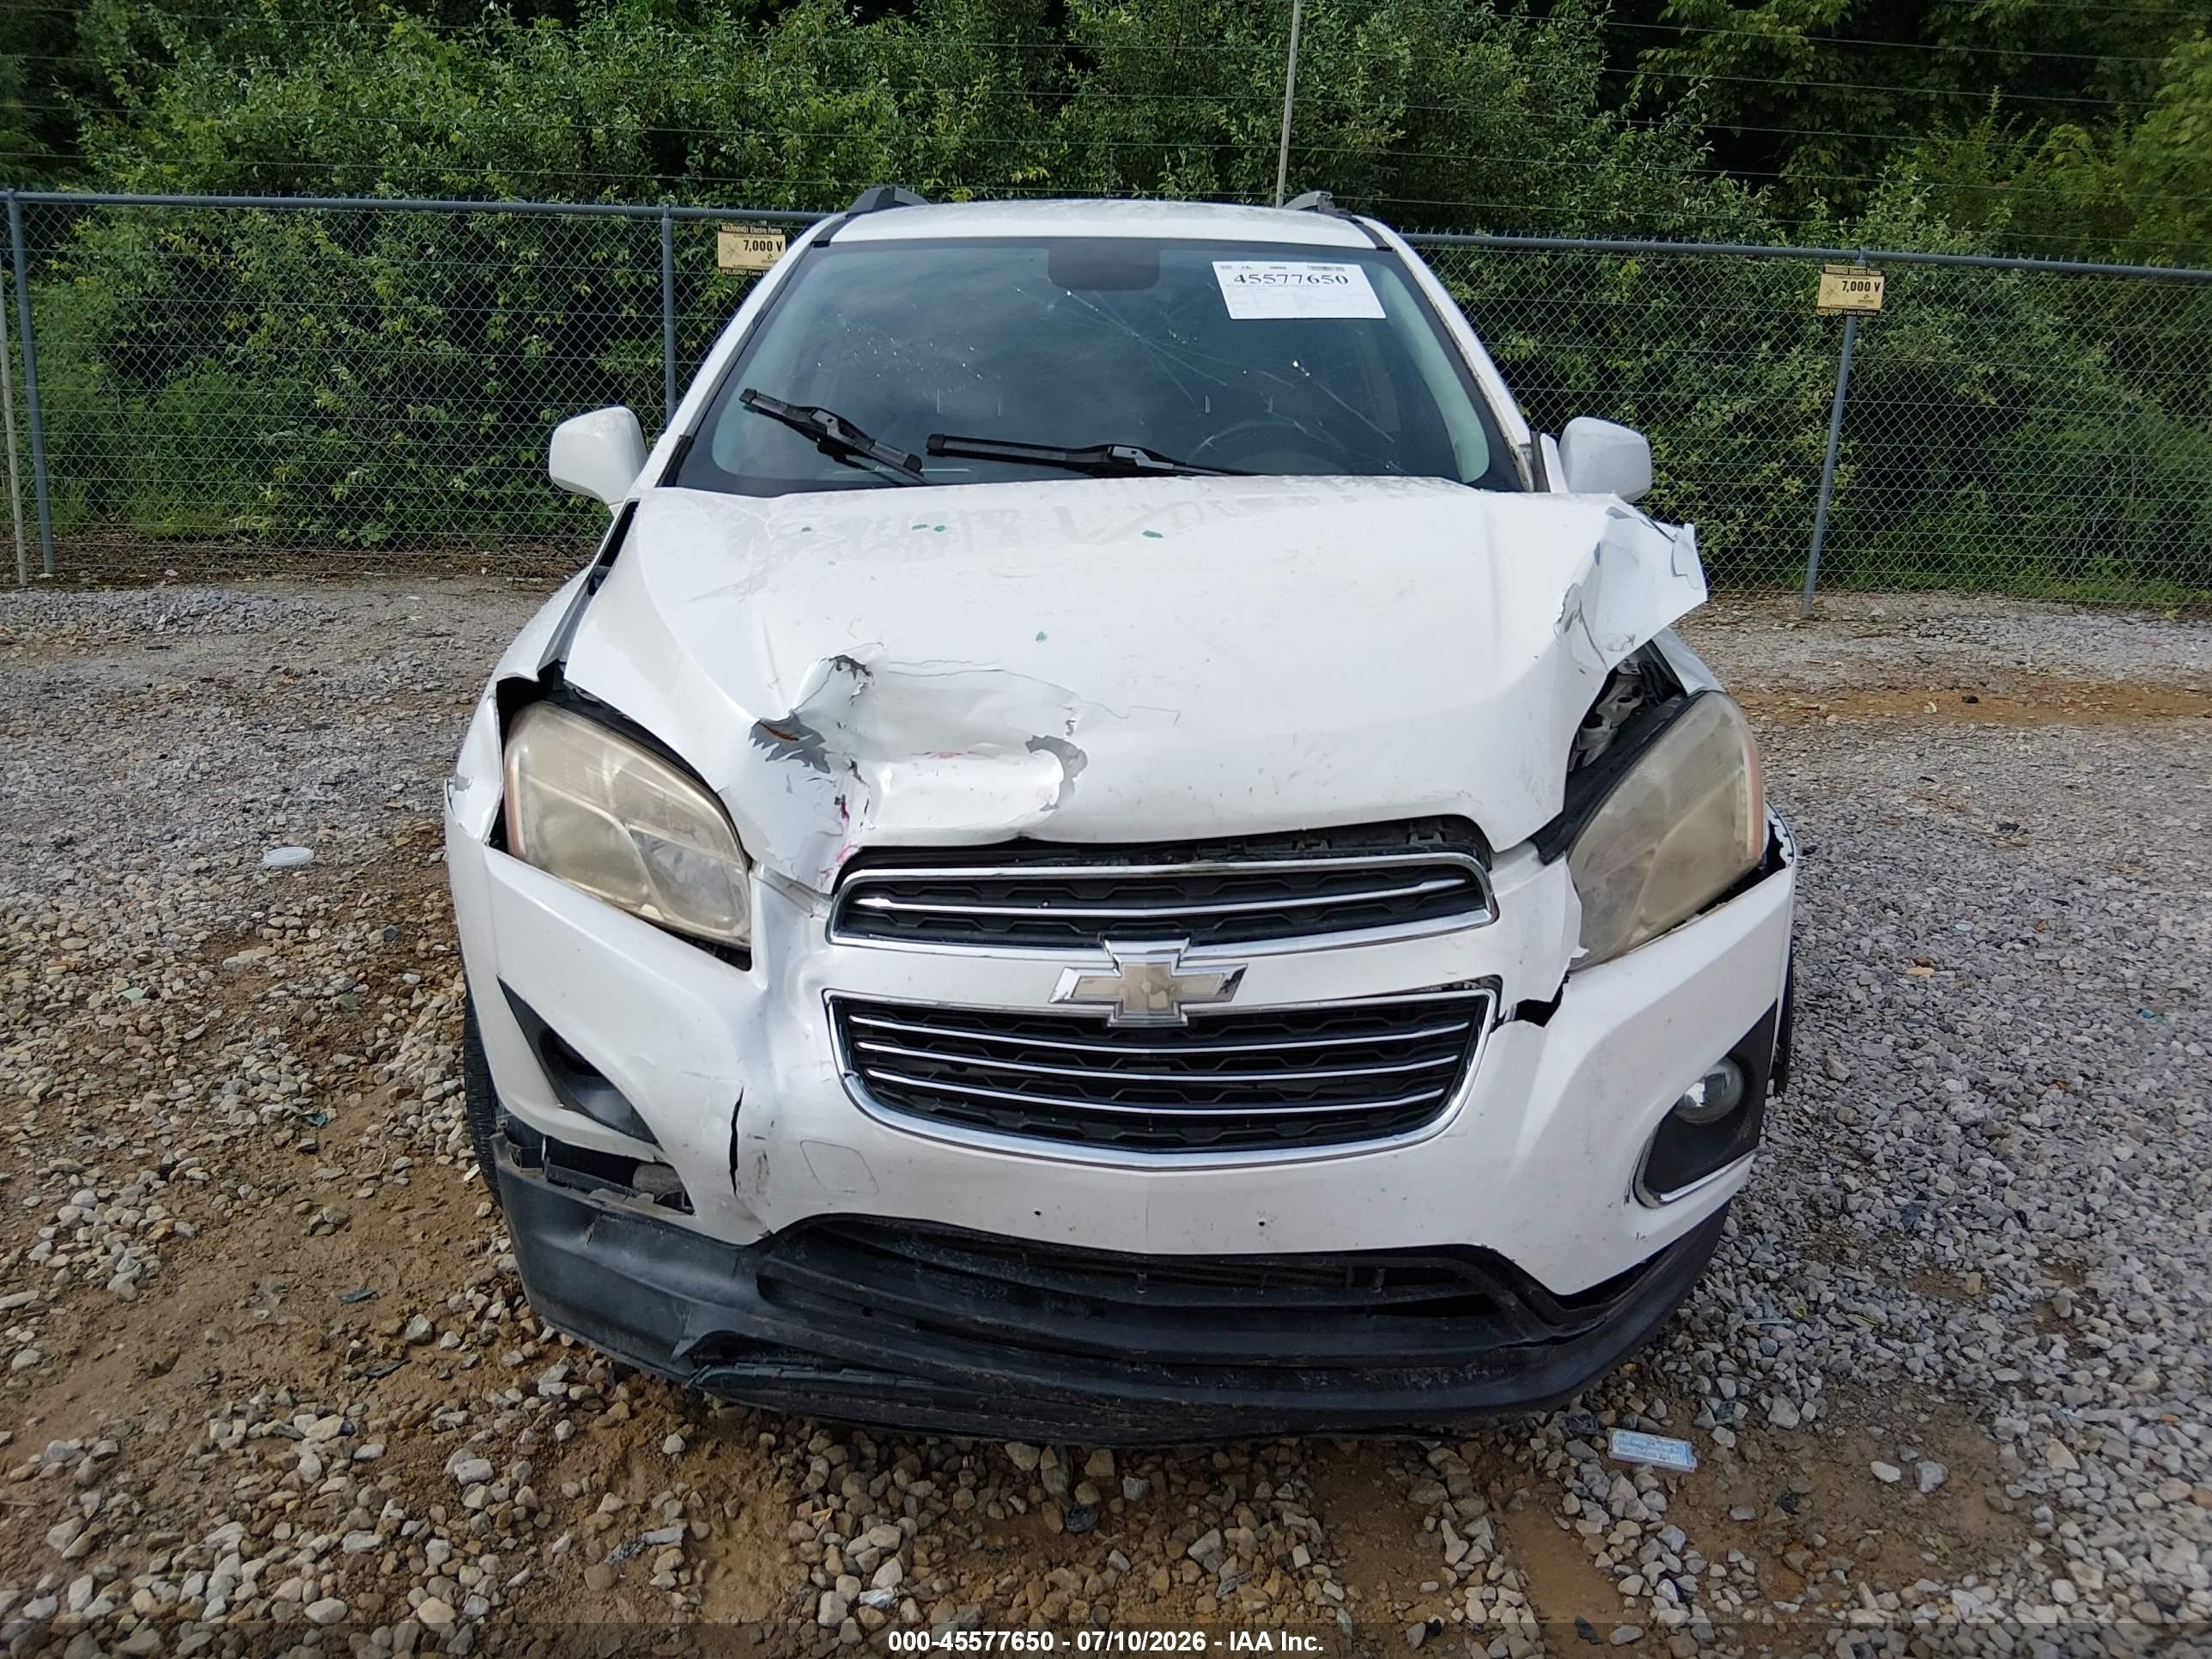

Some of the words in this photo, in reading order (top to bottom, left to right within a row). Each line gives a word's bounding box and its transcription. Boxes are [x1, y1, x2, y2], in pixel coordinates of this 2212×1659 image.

[744, 240, 774, 252] 7,000
[775, 240, 783, 252] V
[1233, 274, 1349, 284] 45577650
[1842, 281, 1870, 293] 7,000
[1875, 282, 1881, 292] V
